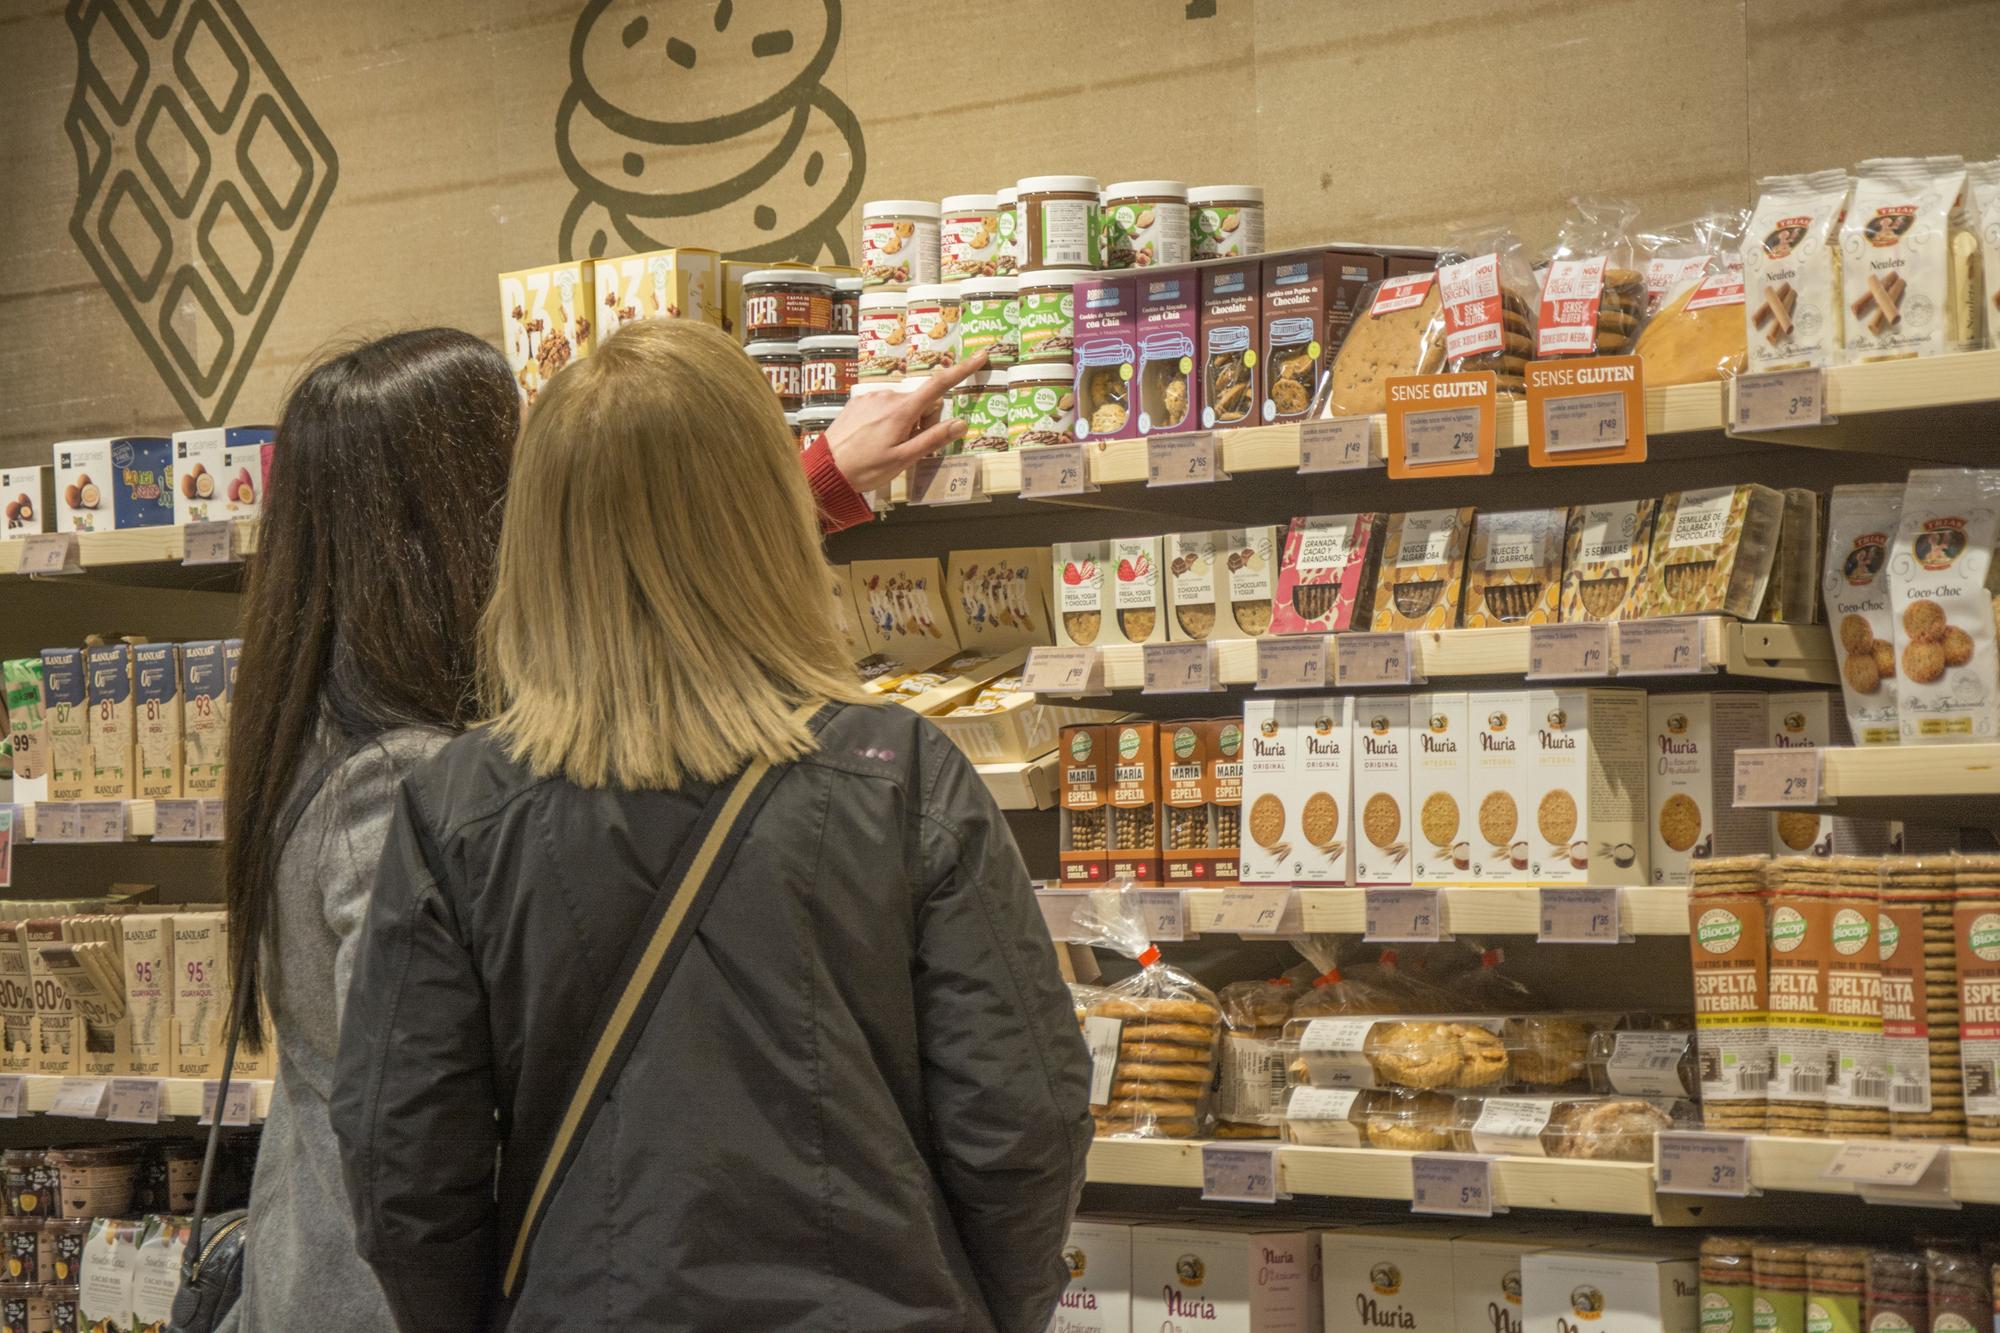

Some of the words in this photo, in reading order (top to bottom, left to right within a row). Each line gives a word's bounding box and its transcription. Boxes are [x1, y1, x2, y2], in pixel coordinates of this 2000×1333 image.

[1870, 258, 1904, 270] Neulets
[1766, 270, 1795, 281] Neulets
[1273, 295, 1311, 307] Chocolate
[1563, 301, 1584, 313] SENSE
[1211, 303, 1246, 315] Chocolate
[1464, 301, 1485, 315] SENSE
[1086, 320, 1100, 329] con
[1148, 314, 1161, 322] con
[1532, 370, 1574, 388] SENSE
[1577, 365, 1635, 384] GLUTEN
[1391, 383, 1430, 401] SENSE
[1433, 380, 1488, 399] GLUTEN
[1453, 432, 1474, 450] 2'99
[1678, 514, 1710, 524] SEMILLAS
[1712, 512, 1722, 521] DE
[1676, 522, 1713, 532] CALABAZA
[1713, 521, 1719, 529] Y
[1674, 530, 1717, 541] CHOCOLATE
[1304, 539, 1339, 548] GRANADA,
[1403, 544, 1429, 554] NUECES
[1430, 543, 1435, 551] Y
[1491, 546, 1520, 555] NUECES
[1522, 545, 1529, 553] Y
[1302, 547, 1325, 556] CACAO
[1401, 551, 1441, 561] ALGARROBA
[1584, 547, 1591, 557] 5
[1591, 544, 1629, 556] SEMILLAS
[1490, 553, 1535, 564] ALGARROBA
[1907, 585, 1962, 599] Coco-Choc
[1069, 598, 1097, 607] CHOCOLATE
[1124, 595, 1152, 604] CHOCOLATE
[1838, 600, 1885, 614] Coco-Choc
[101, 698, 115, 721] 81
[147, 698, 161, 721] 81
[195, 694, 212, 717] 93
[56, 702, 72, 724] 87
[12, 721, 27, 731] ECO
[13, 734, 37, 752] 99%
[1306, 735, 1341, 755] Nuria
[1363, 735, 1399, 755] Nuria
[1420, 732, 1457, 753] Nuria
[1479, 731, 1517, 752] Nuria
[1538, 729, 1576, 750] Nuria
[1658, 734, 1698, 755] Nuria
[1252, 737, 1287, 757] Nuria
[1252, 762, 1286, 771] ORIGINAL
[1306, 761, 1340, 769] ORIGINAL
[1364, 761, 1399, 769] ORIGINAL
[1067, 790, 1097, 802] ESPELTA
[1115, 789, 1145, 801] ESPELTA
[1170, 788, 1202, 800] ESPELTA
[1700, 922, 1740, 940] Biocop
[136, 961, 152, 983] 95
[187, 961, 204, 983] 95
[34, 979, 73, 1011] 80%
[1263, 1247, 1295, 1265] Nuria
[1164, 1285, 1217, 1320] Nuria
[1356, 1293, 1417, 1331] Nuria
